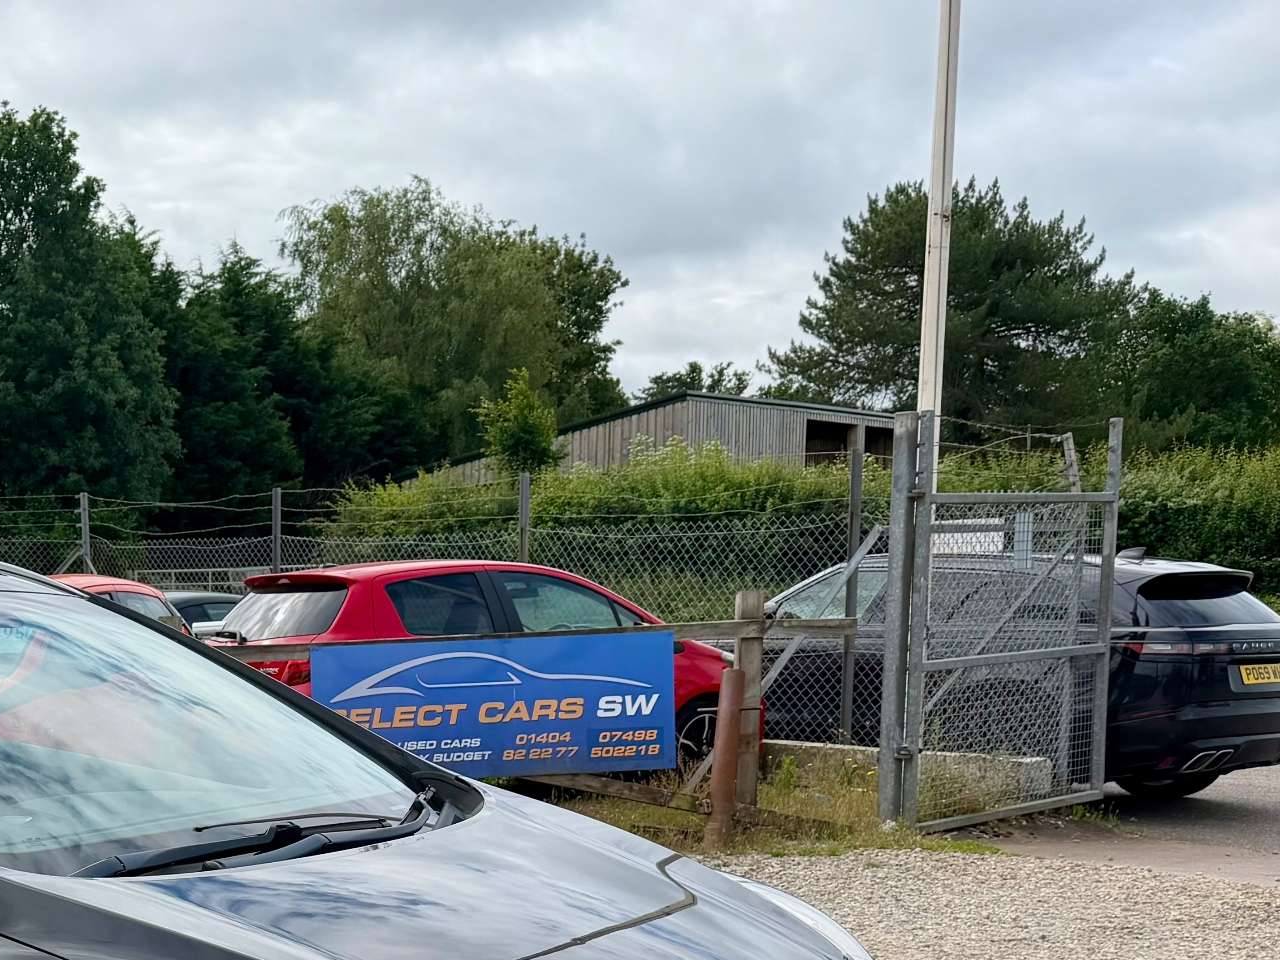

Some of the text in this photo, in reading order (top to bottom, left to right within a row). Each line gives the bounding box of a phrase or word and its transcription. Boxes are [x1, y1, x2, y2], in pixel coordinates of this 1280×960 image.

[336, 693, 660, 730] ELECT CARS SW
[515, 731, 572, 746] 01404
[598, 729, 658, 743] 07498
[440, 738, 481, 750] CARS
[432, 751, 493, 763] BUDGET
[590, 744, 660, 759] 502218
